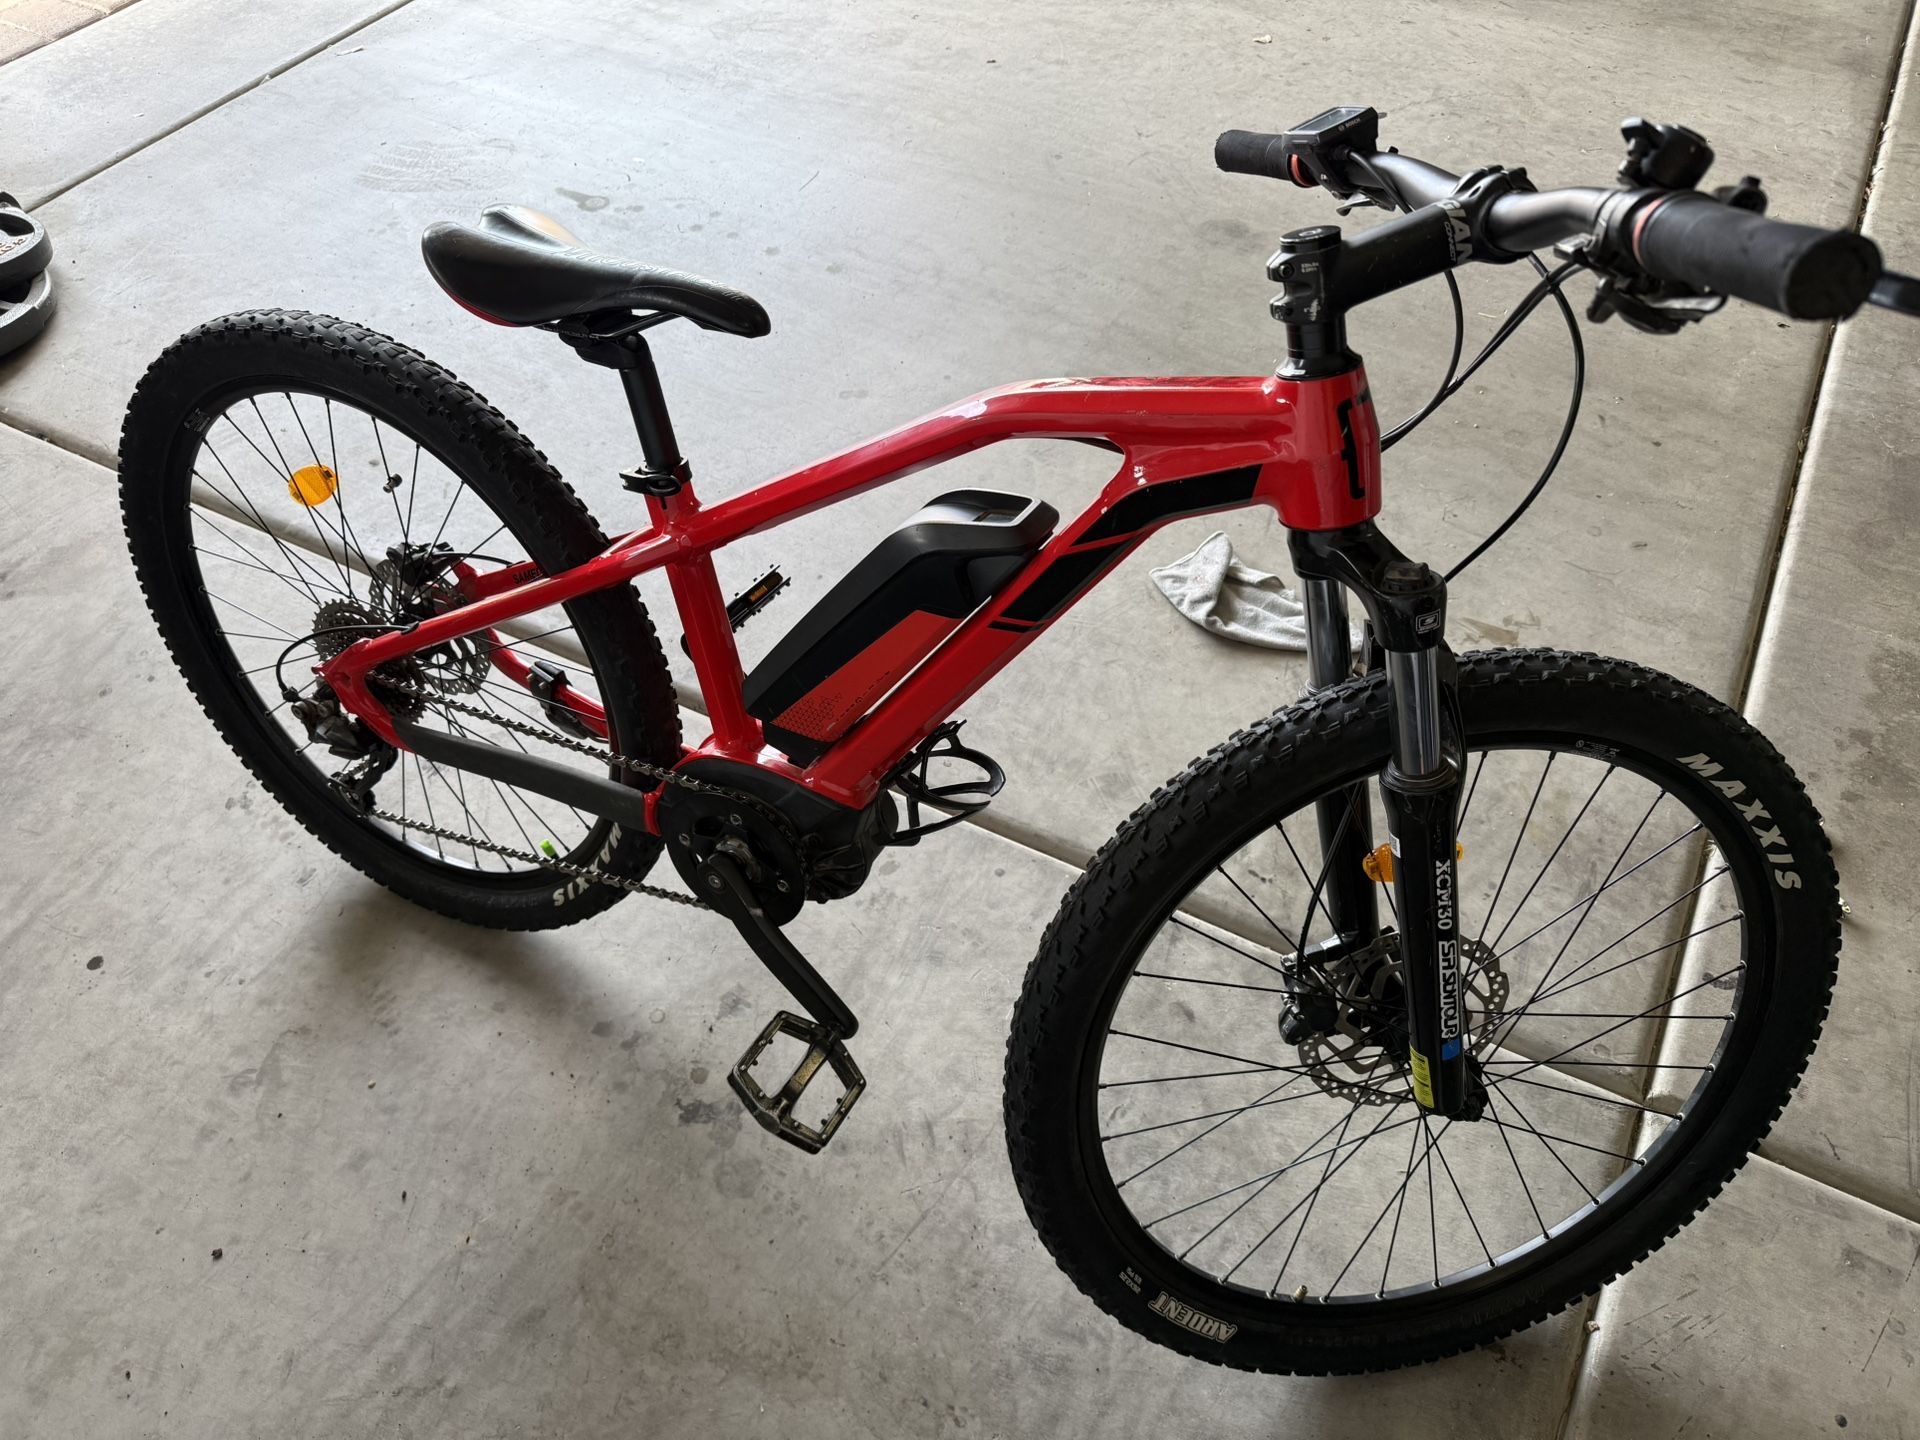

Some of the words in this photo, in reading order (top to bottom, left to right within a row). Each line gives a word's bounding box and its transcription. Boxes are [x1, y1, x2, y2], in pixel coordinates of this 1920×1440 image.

[1676, 752, 1802, 890] MAXXIS
[1435, 858, 1453, 931] XCM30
[1149, 1292, 1237, 1342] ARDENT
